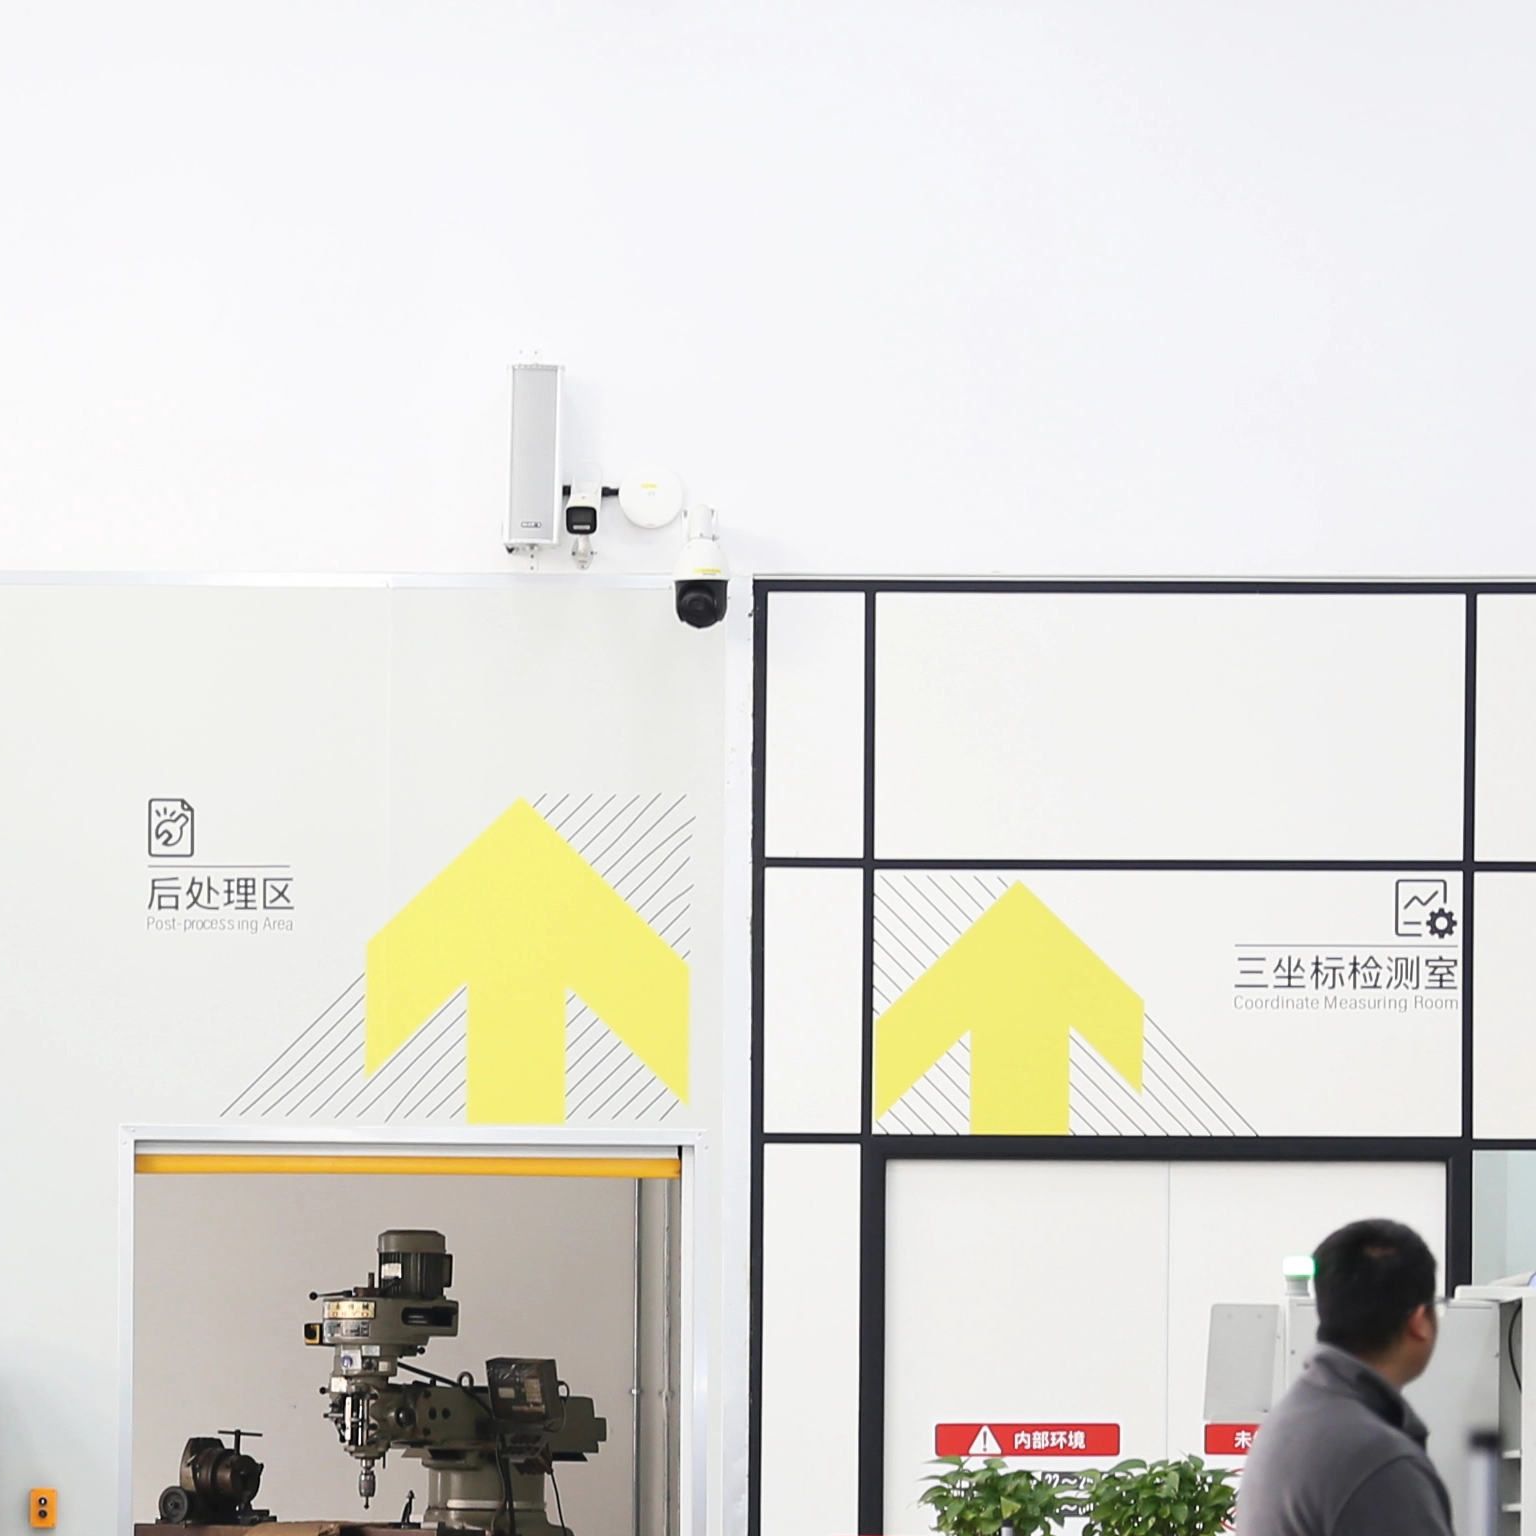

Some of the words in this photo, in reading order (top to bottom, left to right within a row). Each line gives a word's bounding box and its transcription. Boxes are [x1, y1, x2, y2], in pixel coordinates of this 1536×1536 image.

[147, 875, 295, 911] 后处理区
[146, 916, 259, 934] Post-processing
[262, 916, 294, 932] Area
[1234, 955, 1459, 991] 三坐标检测室
[1233, 995, 1320, 1011] Coordinate
[1323, 995, 1408, 1013] Measuring
[1413, 995, 1459, 1011] Room
[1014, 1430, 1086, 1450] 内部环境
[1234, 1430, 1259, 1449] 未
